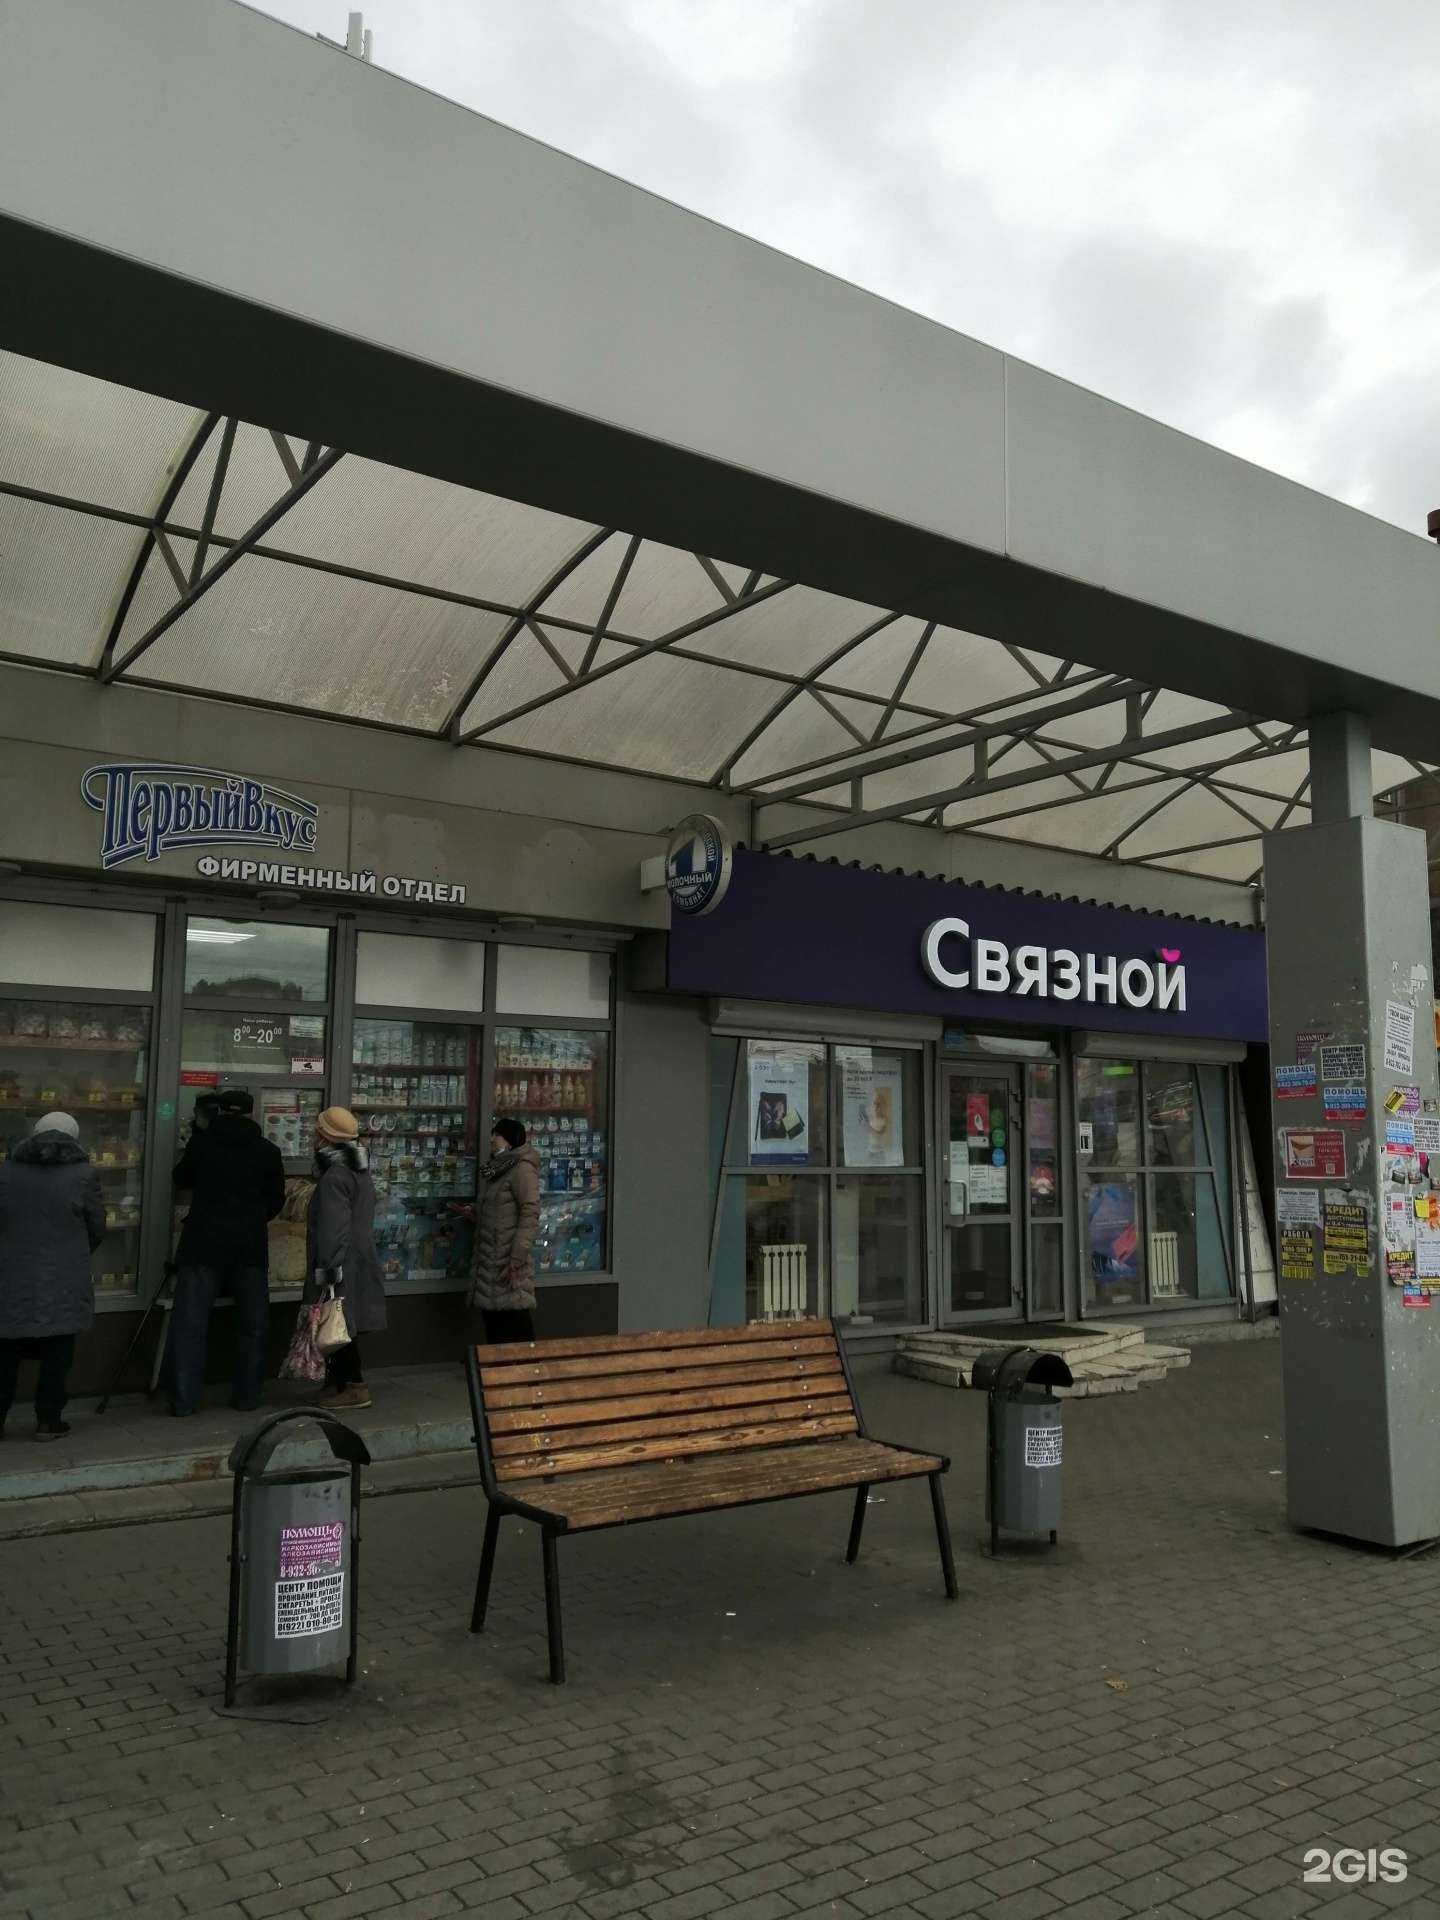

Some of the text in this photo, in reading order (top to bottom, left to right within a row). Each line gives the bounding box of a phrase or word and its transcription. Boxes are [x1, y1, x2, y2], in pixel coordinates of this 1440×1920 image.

[197, 855, 467, 904] ФИРМЕННЫЙ ОТДЕЛ
[1326, 1206, 1364, 1216] КРЕДИТ
[281, 1525, 333, 1539] ПОМОЩЬ
[278, 1575, 341, 1593] ЦЕНТР ПОМОЩИ
[278, 1600, 313, 1610] СИГАРЕТЫ
